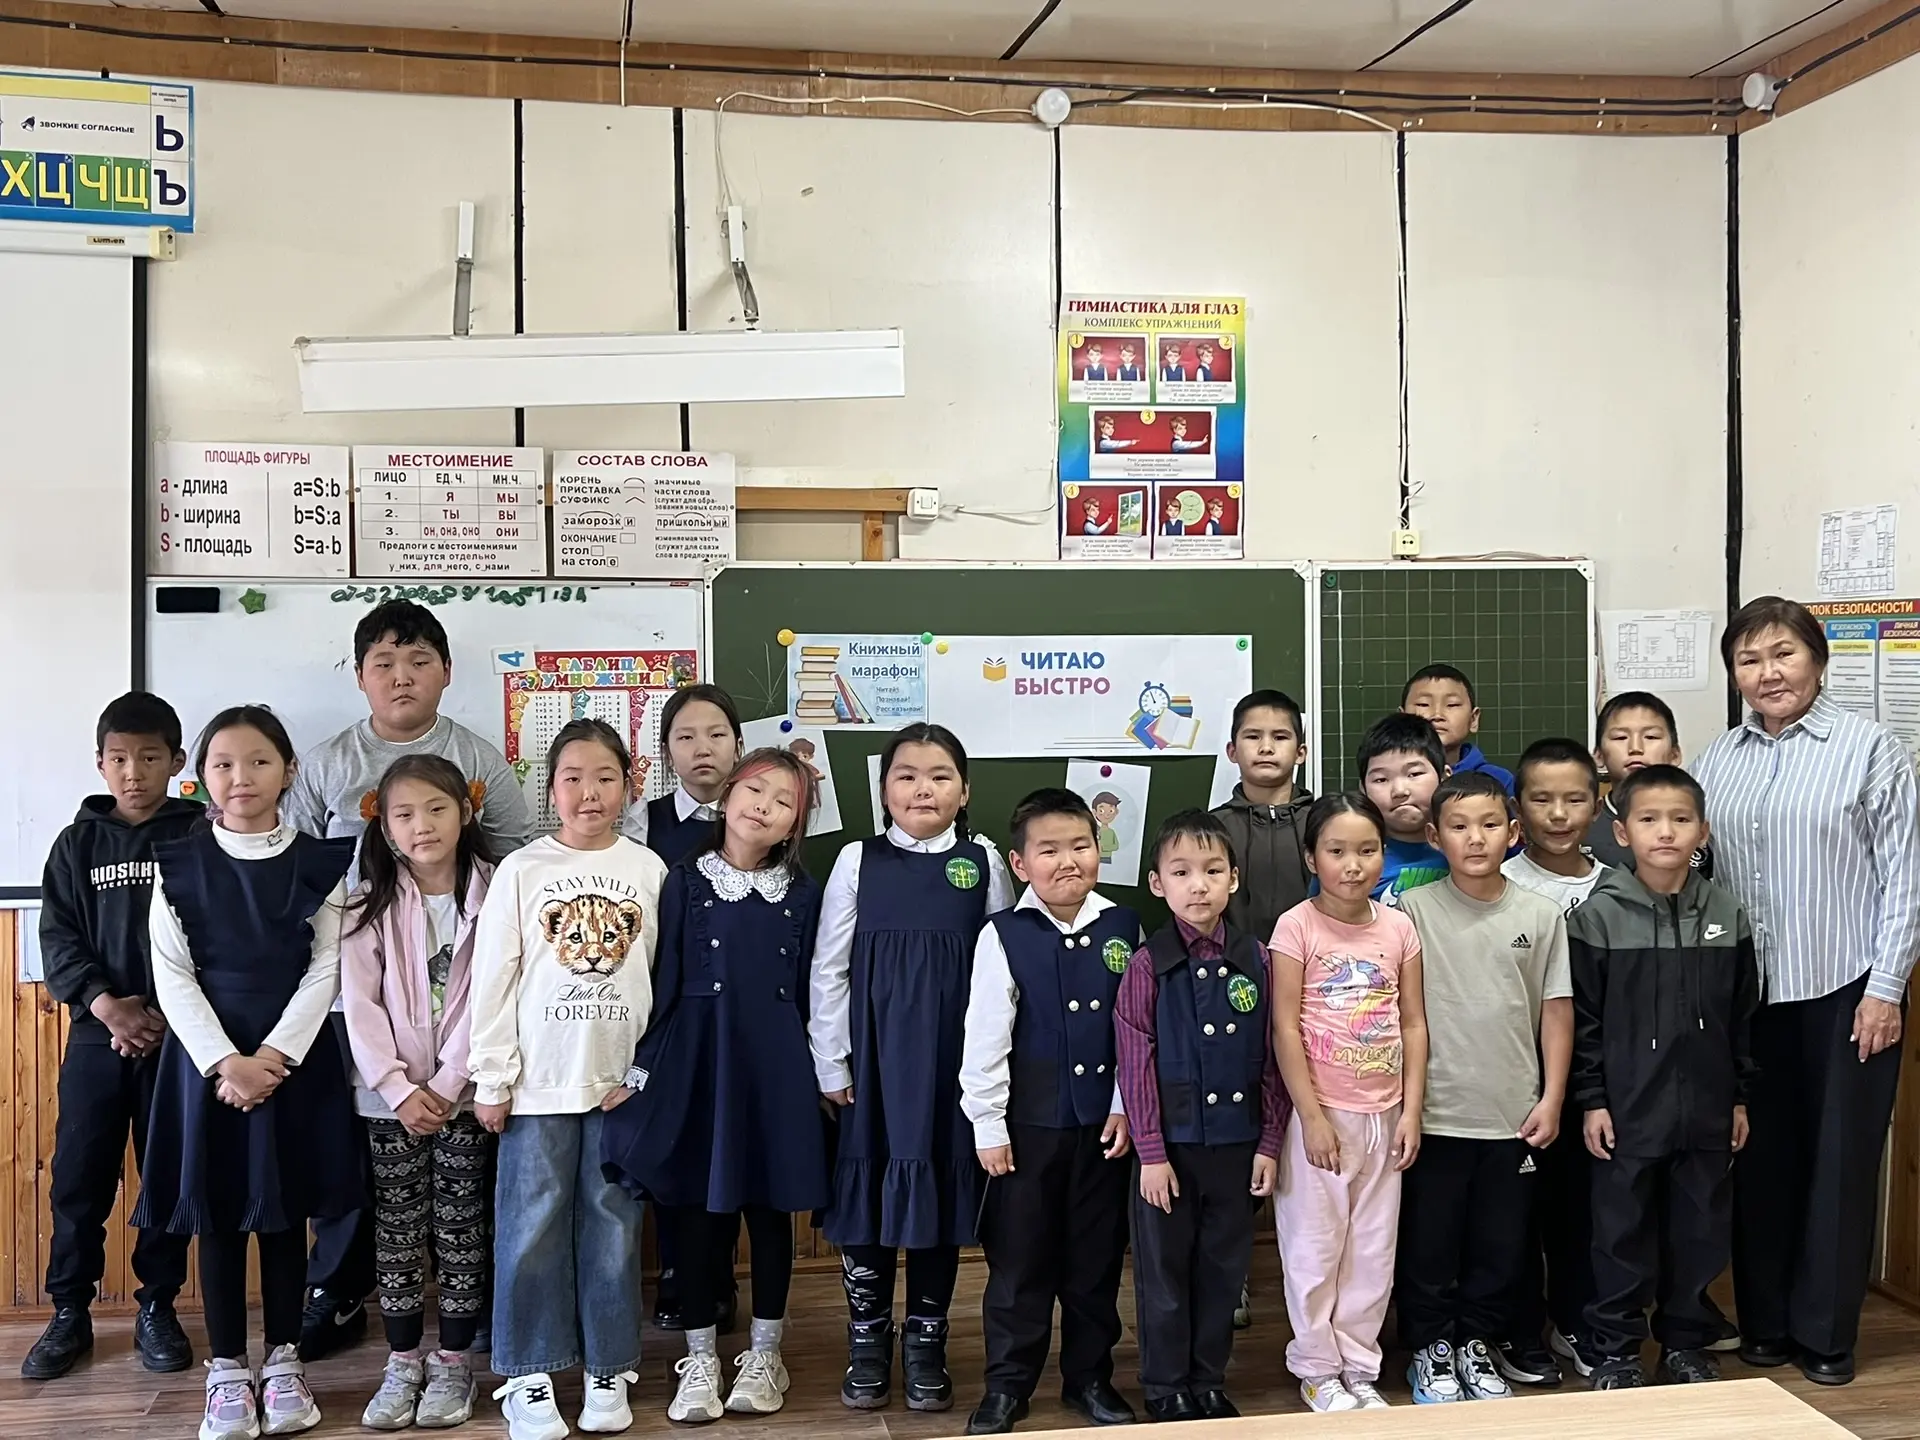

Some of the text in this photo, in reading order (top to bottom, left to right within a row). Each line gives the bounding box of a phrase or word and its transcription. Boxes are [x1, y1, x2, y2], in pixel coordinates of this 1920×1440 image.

[40, 121, 134, 133] ЗВОНКИЕ СОГЛАСНЫЕ
[39, 161, 71, 205] Ц
[80, 164, 107, 201] Ч
[115, 166, 149, 209] Щ
[1068, 301, 1239, 315] ГИМНАСТИКА ДЛЯ ГЛАЗ
[1084, 317, 1222, 329] КОМПЛЕКС УПРАЖНЕНИЙ
[205, 450, 310, 465] ПЛОЩАДЬ ФИГУРЫ
[388, 455, 513, 467] МЕСТОИМЕНИЕ
[577, 455, 708, 467] СОСТАВ СЛОВА
[374, 472, 406, 483] ЛИЦО
[560, 476, 601, 484] КОРЕНЬ
[182, 478, 228, 497] длина
[560, 486, 621, 494] ПРИСТАВКА
[385, 492, 398, 500] 1.
[560, 496, 610, 504] СУФФИКС
[184, 508, 240, 528] ширина
[385, 509, 398, 518] 2.
[385, 527, 399, 536] 3.
[560, 534, 617, 543] ОКОНЧАНИЕ
[184, 538, 252, 557] площадь
[379, 541, 428, 551] Предлоги
[438, 542, 517, 551] местоимениями
[561, 547, 590, 555] стол
[403, 553, 496, 561] пишутся отдельно
[1805, 601, 1913, 616] ОЛОК БЕЗОПАСНОСТИ
[849, 643, 920, 655] Книжный
[557, 657, 648, 672] ТАБЛИЦА
[1021, 652, 1105, 670] ЧИТАЮ
[852, 664, 918, 679] марафон
[541, 672, 665, 687] УМНОЖЕНИЯ
[1014, 677, 1111, 695] БЫСТРО
[543, 875, 638, 899] STAY WILD
[557, 982, 622, 1001] Little One
[544, 1004, 630, 1022] FOREVER
